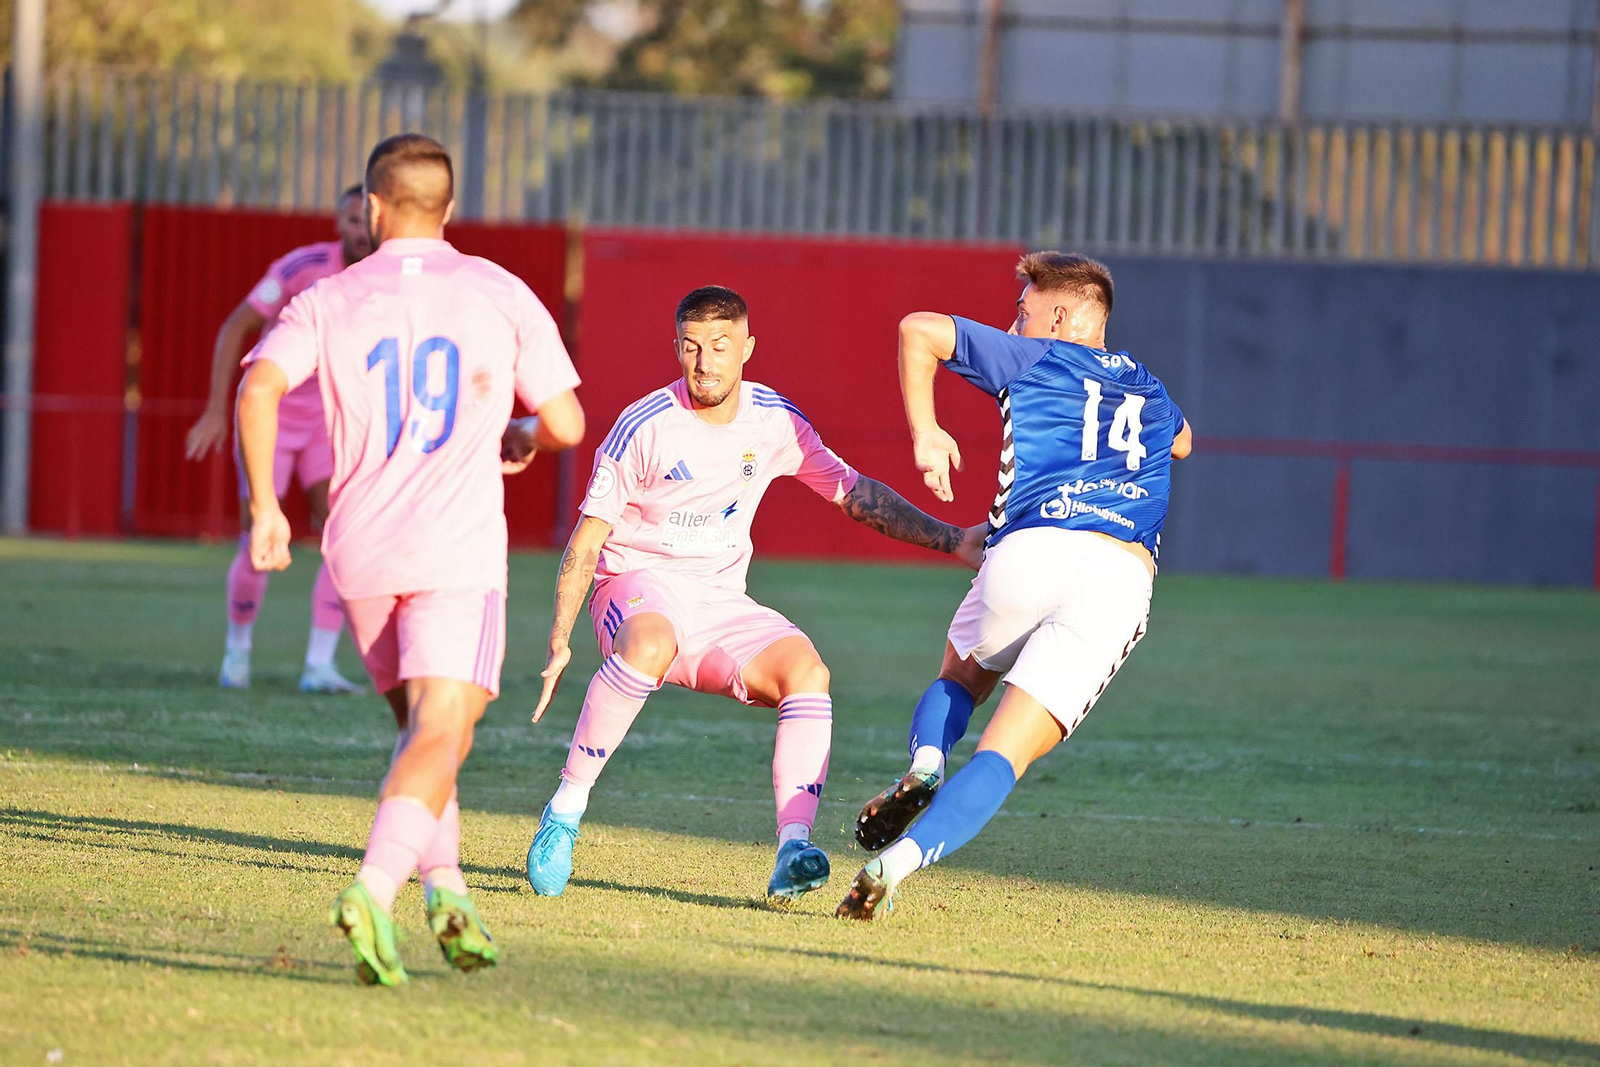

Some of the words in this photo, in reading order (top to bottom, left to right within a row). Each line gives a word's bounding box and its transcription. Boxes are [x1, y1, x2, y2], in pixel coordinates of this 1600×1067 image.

[367, 336, 460, 459] 19
[1081, 378, 1147, 471] 14
[665, 527, 737, 544] enersun
[668, 510, 711, 527] alter
